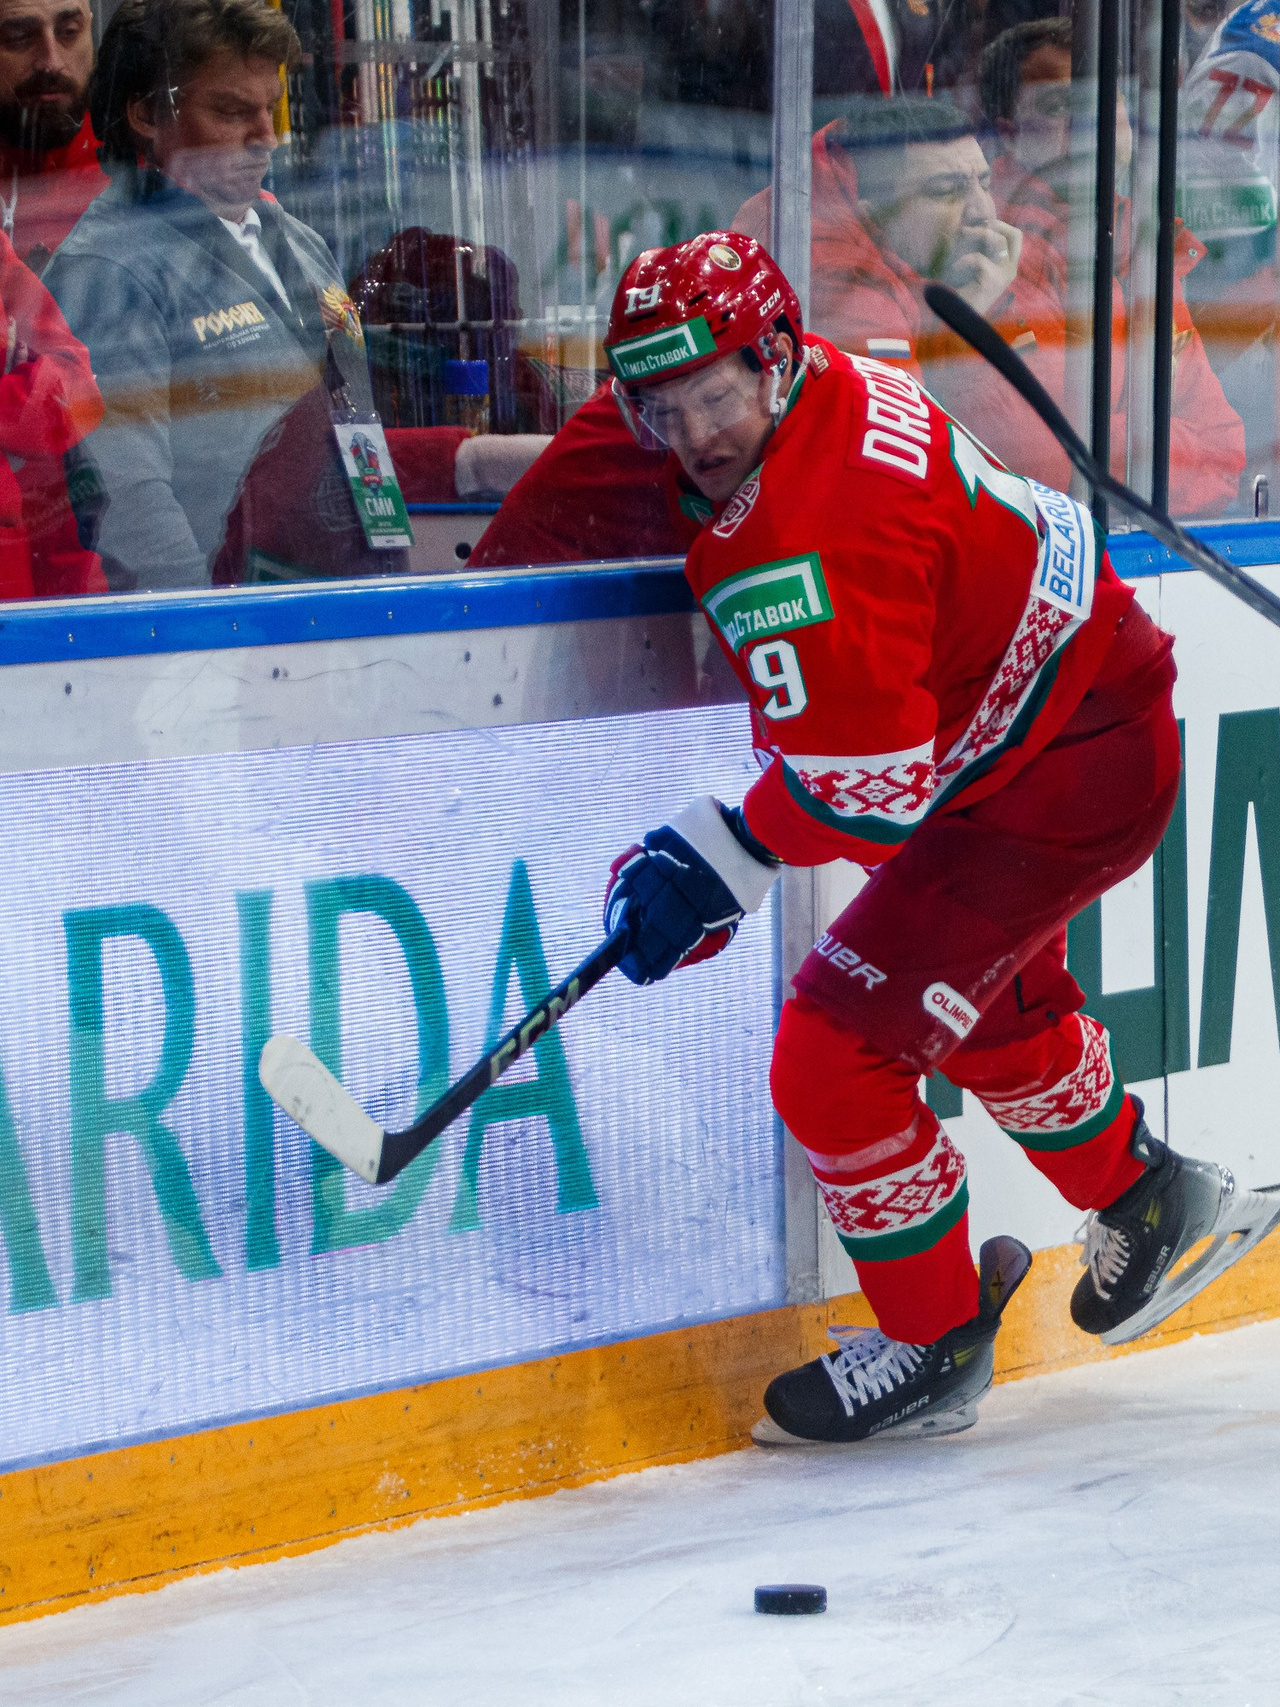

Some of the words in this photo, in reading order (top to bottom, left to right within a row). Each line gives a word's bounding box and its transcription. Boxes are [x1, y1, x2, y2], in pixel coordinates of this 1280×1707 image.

[1198, 68, 1274, 151] 72
[624, 284, 662, 315] 19
[758, 289, 782, 317] CCM
[192, 300, 266, 343] РОССИЯ
[364, 497, 397, 517] СМИ
[489, 976, 581, 1084] CCM
[1142, 1244, 1171, 1294] BAUER
